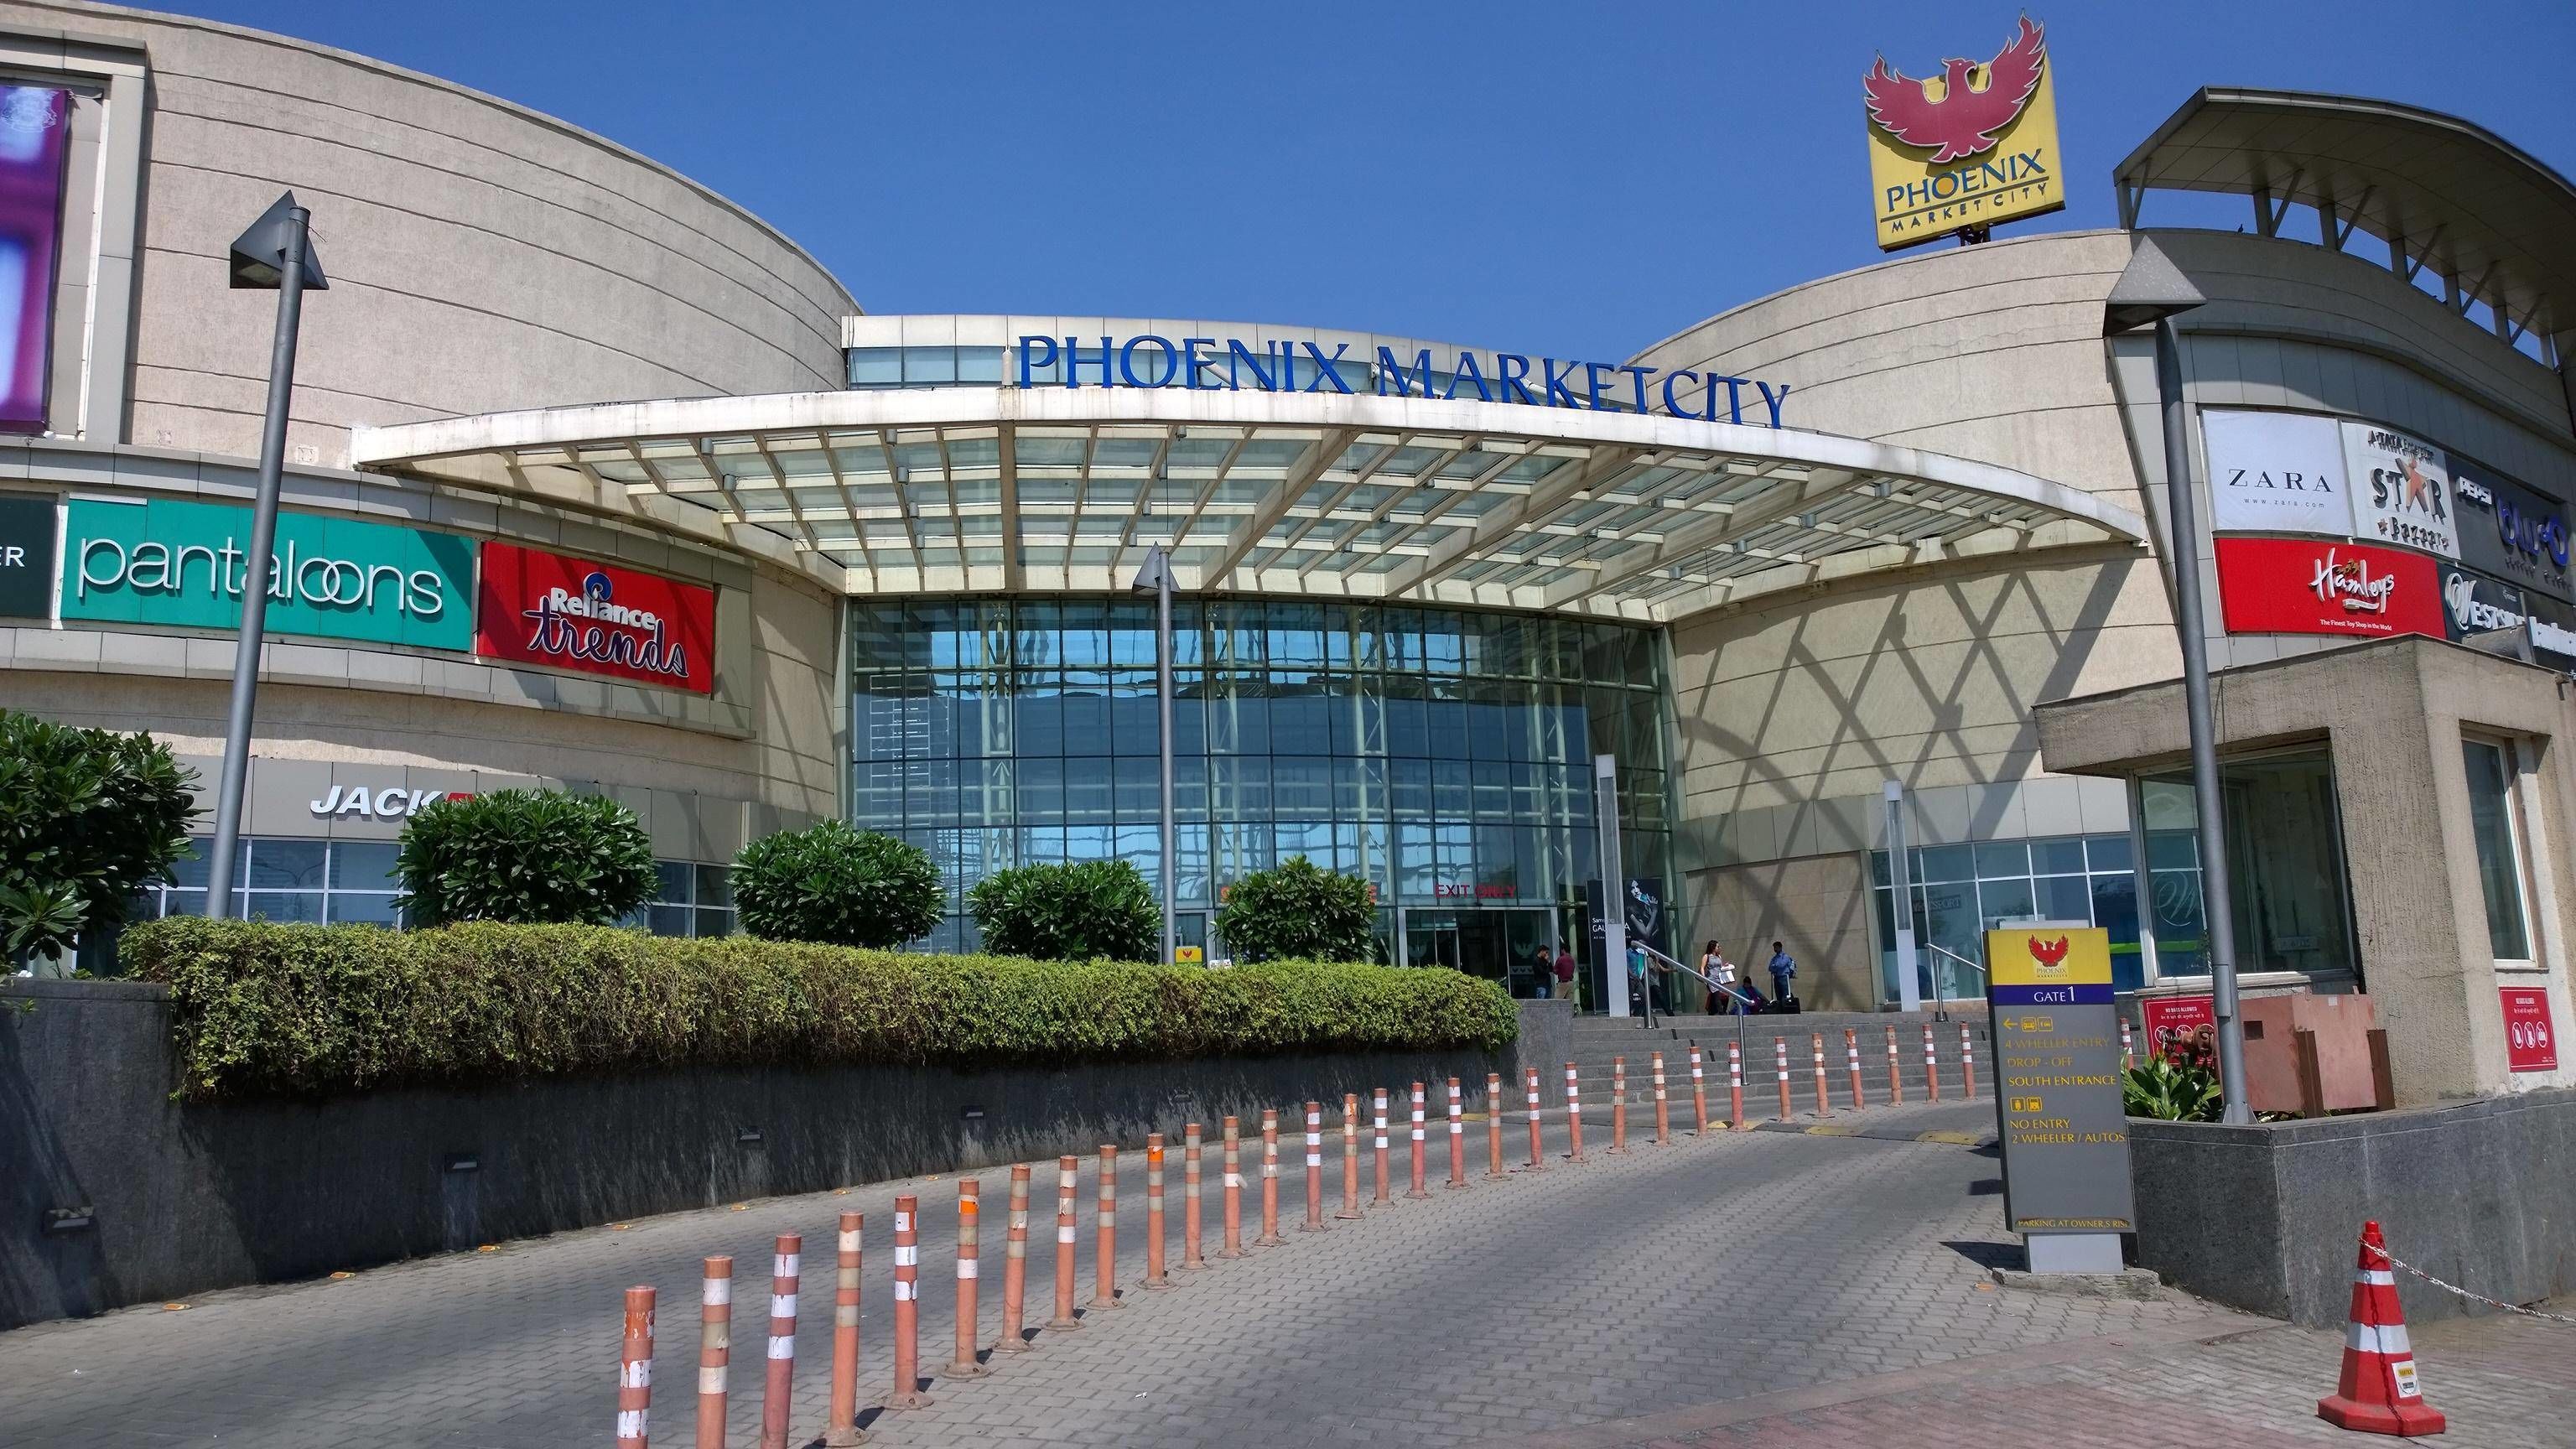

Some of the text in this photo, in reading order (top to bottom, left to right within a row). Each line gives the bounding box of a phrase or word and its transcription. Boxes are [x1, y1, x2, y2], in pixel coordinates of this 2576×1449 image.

[1887, 148, 2046, 213] PHOENIX
[1892, 182, 2048, 234] MARKETCITY
[1021, 335, 1791, 429] PHOENIX MARKETCITY
[2228, 469, 2334, 493] ZARA
[2458, 475, 2492, 506] PEPSI
[2389, 517, 2442, 545] Bazaar
[2308, 547, 2395, 614] Hamleys
[550, 587, 656, 631] Reliance
[522, 595, 689, 678] trends
[2346, 620, 2355, 628] Toy
[2355, 621, 2367, 629] Shop
[309, 785, 443, 817] JACK
[1435, 884, 1518, 898] EXIT ONLY
[2033, 985, 2075, 1002] GATE 1
[2072, 1036, 2110, 1047] ENTRY
[2007, 1057, 2041, 1067] DROP
[2051, 1057, 2073, 1067] OFF
[2008, 1075, 2116, 1087] SOUTH ENTRANCE
[2009, 1119, 2070, 1130] NO ENTRY
[2012, 1135, 2018, 1144] 2
[2022, 1134, 2075, 1143] WHEELER
[2085, 1133, 2127, 1142] AUTOS
